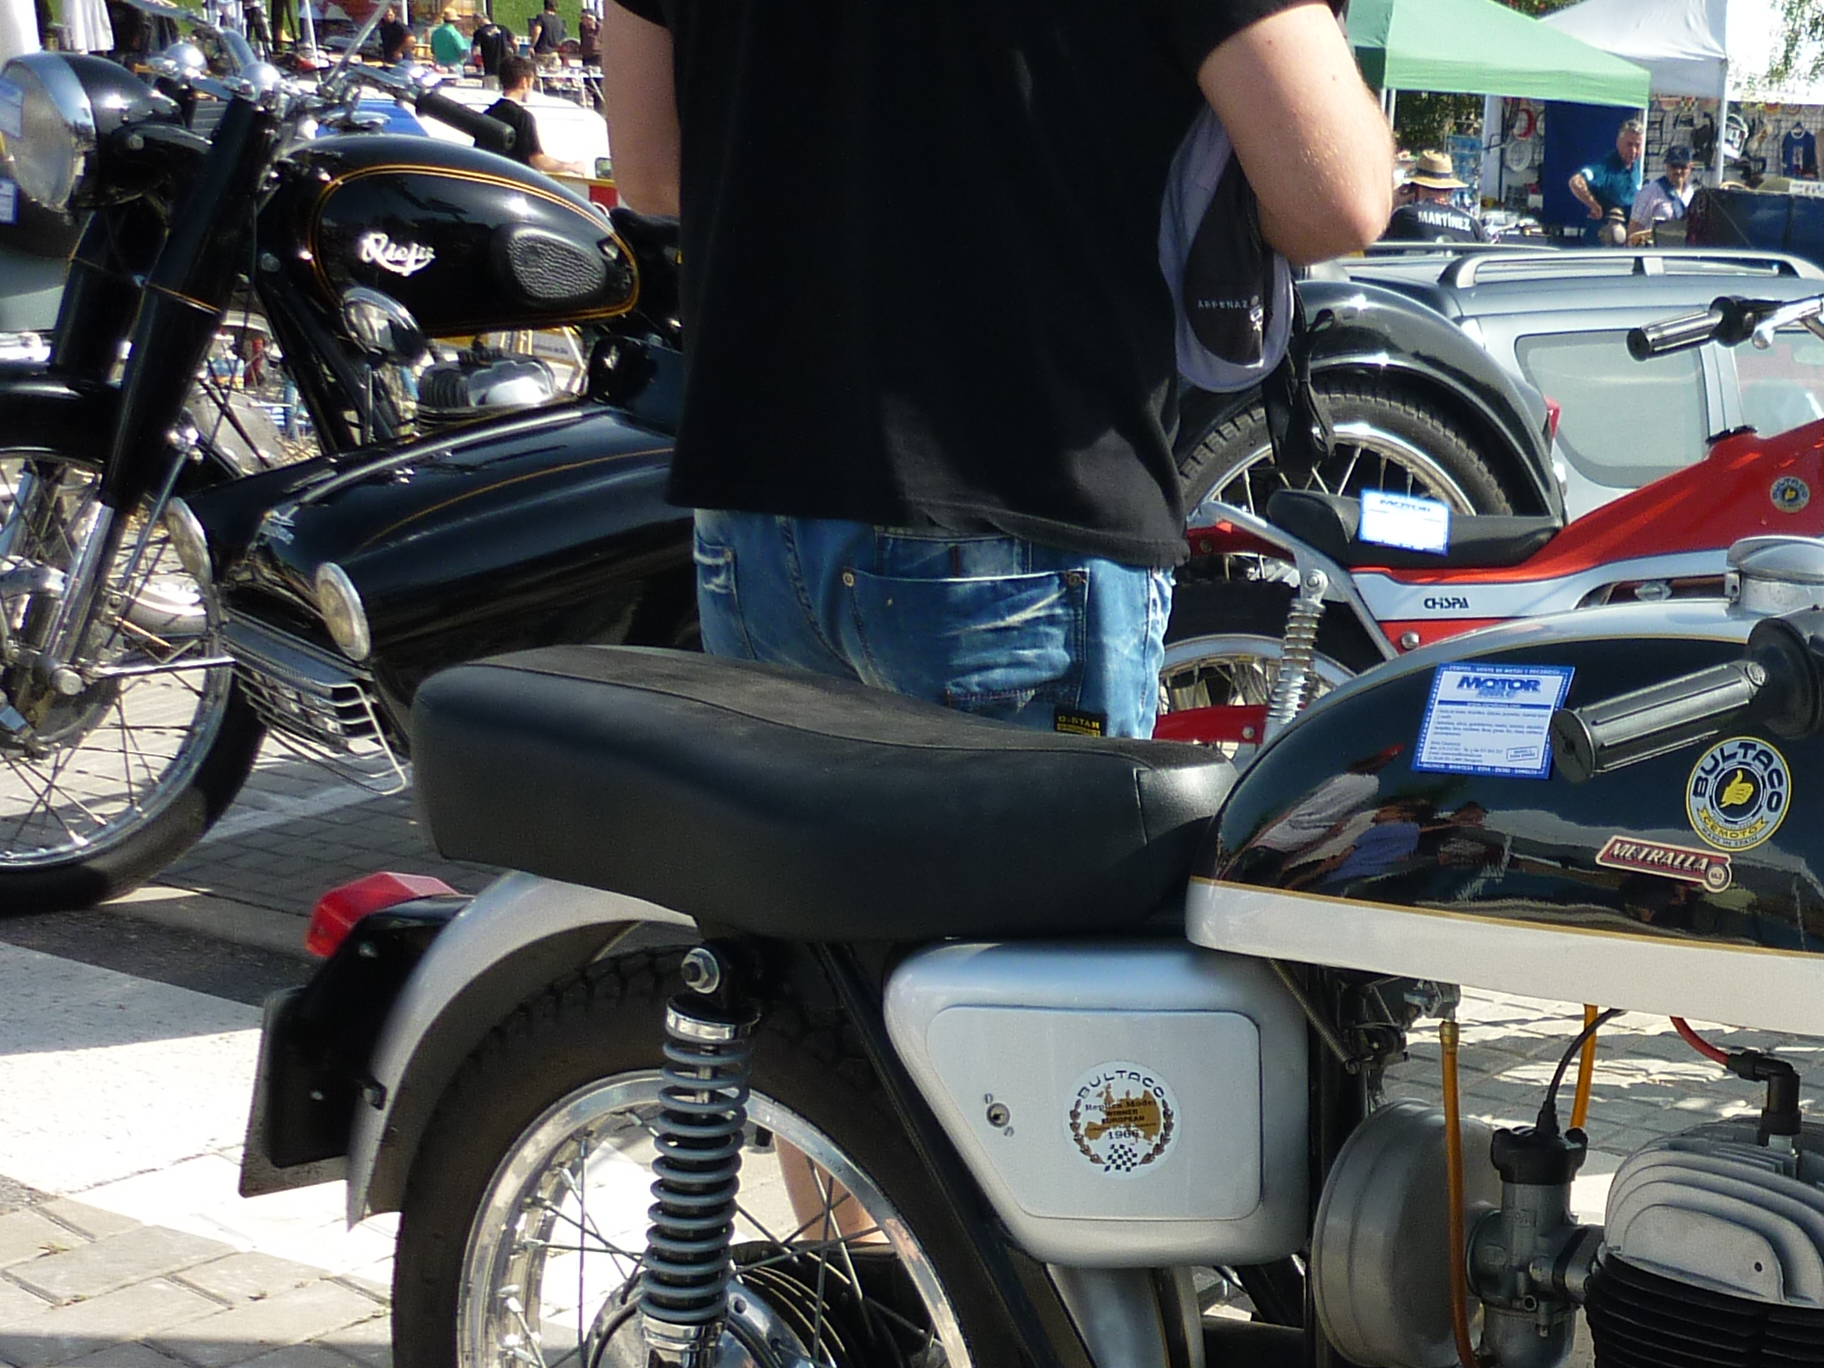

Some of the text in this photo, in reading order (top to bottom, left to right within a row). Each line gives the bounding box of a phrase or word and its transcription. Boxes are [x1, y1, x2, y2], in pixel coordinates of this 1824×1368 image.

[1418, 210, 1471, 231] MARTÍNEZ
[1457, 675, 1541, 692] MOTOR
[1692, 742, 1784, 813] BULTACO
[1609, 842, 1710, 874] METRALLA
[1077, 1070, 1165, 1099] BULTACO
